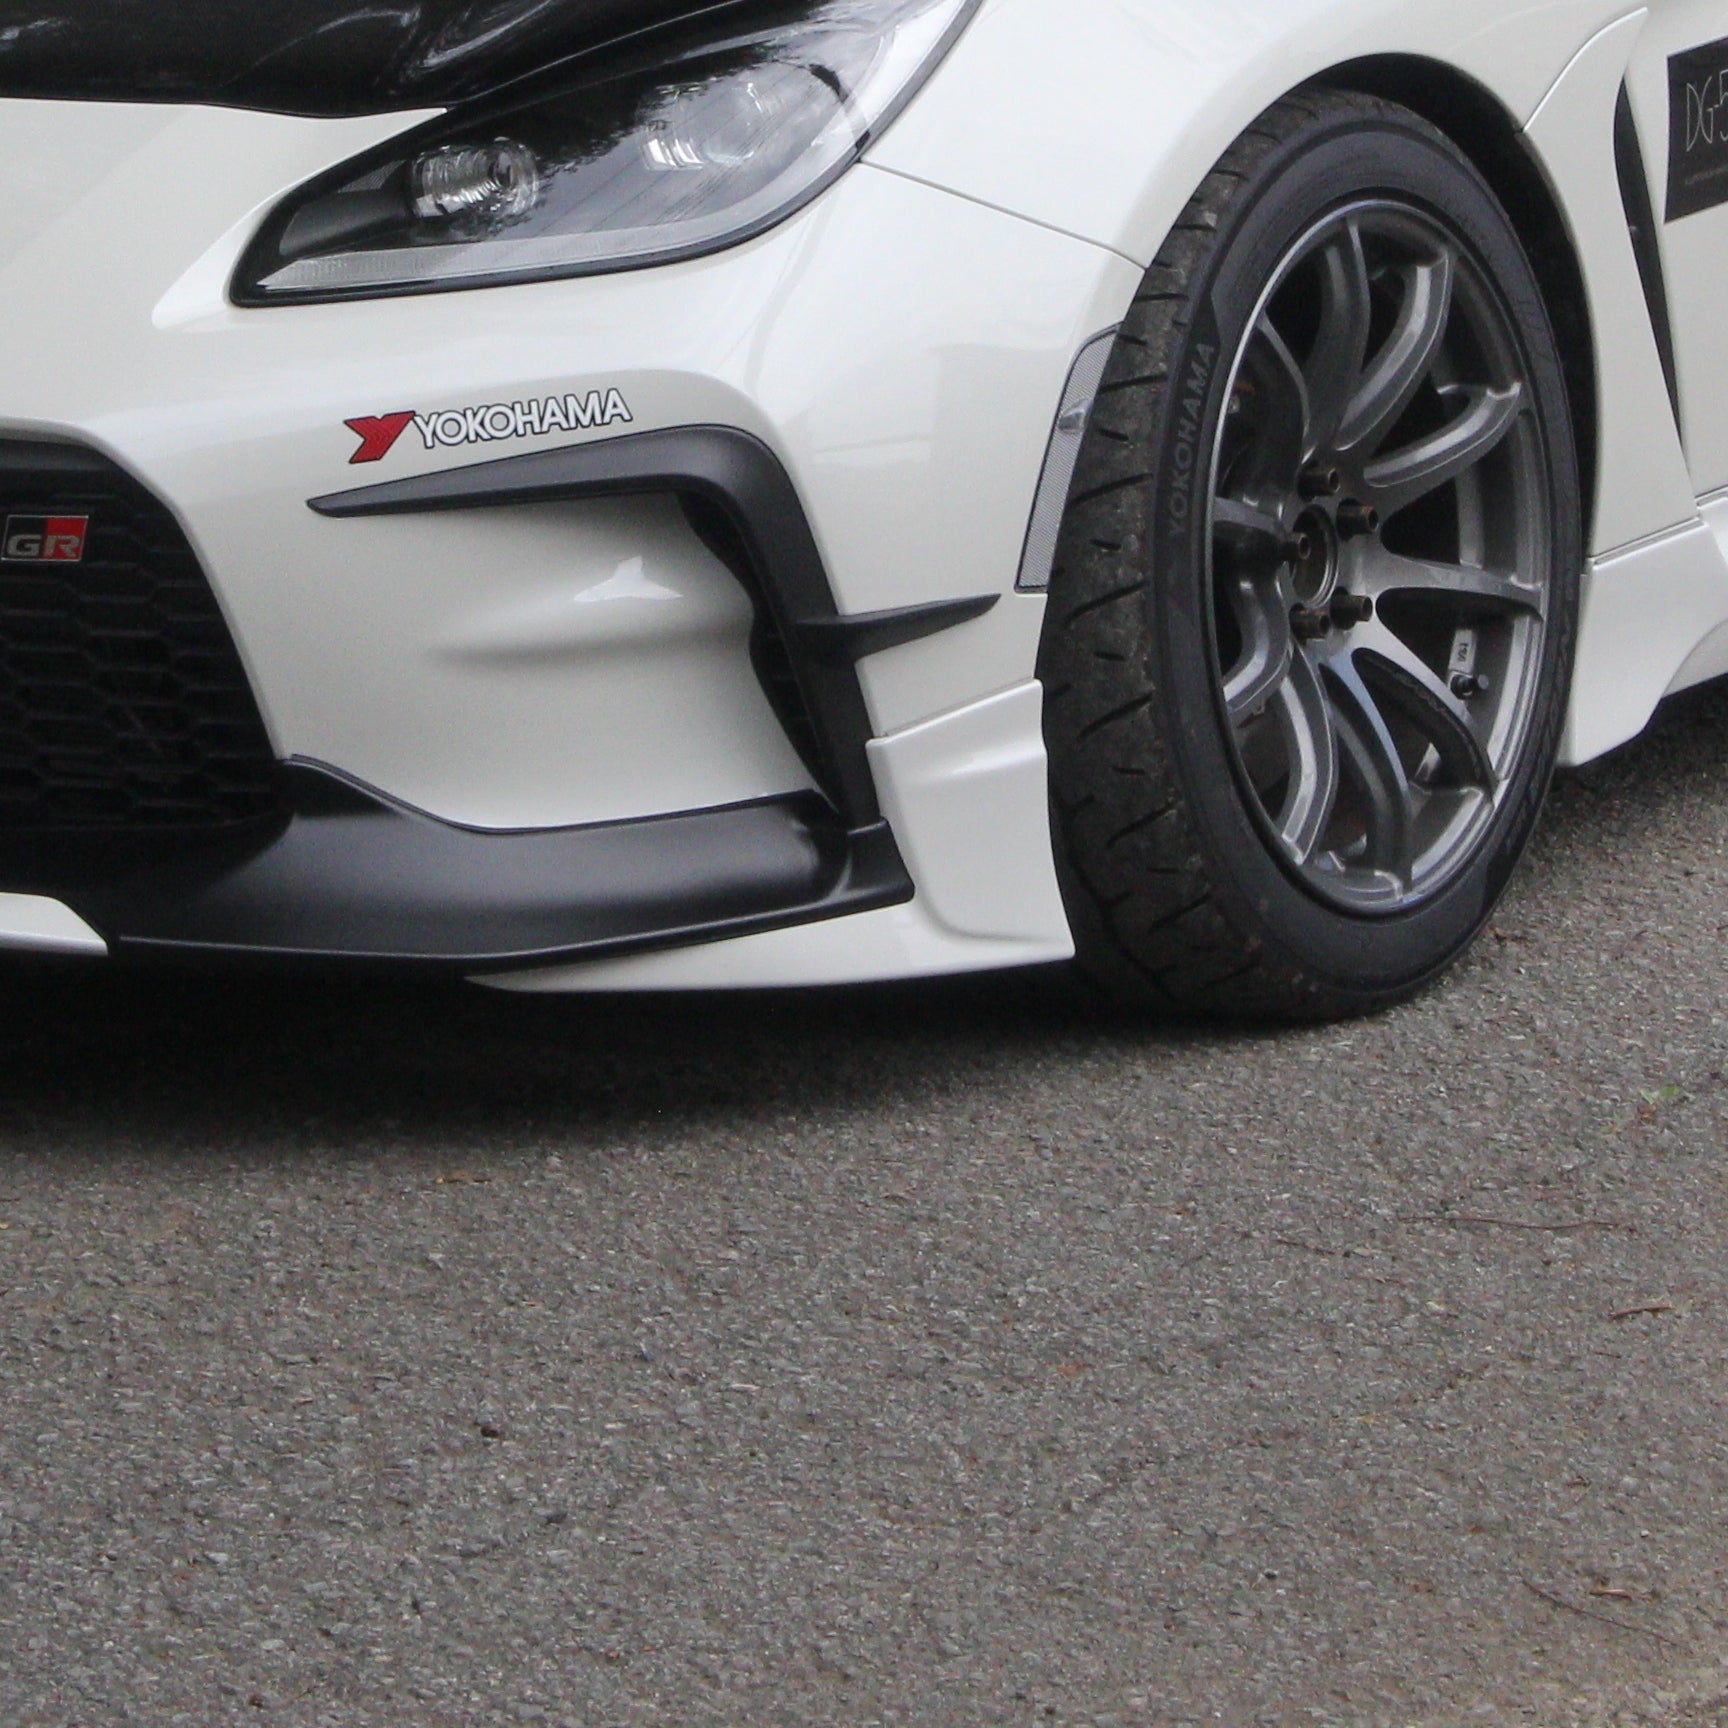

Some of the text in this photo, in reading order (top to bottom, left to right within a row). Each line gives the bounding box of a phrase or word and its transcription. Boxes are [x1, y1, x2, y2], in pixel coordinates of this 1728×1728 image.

[413, 388, 633, 449] YOKOHAMA
[1171, 342, 1215, 538] YOKOHAMA
[7, 534, 80, 558] GR
